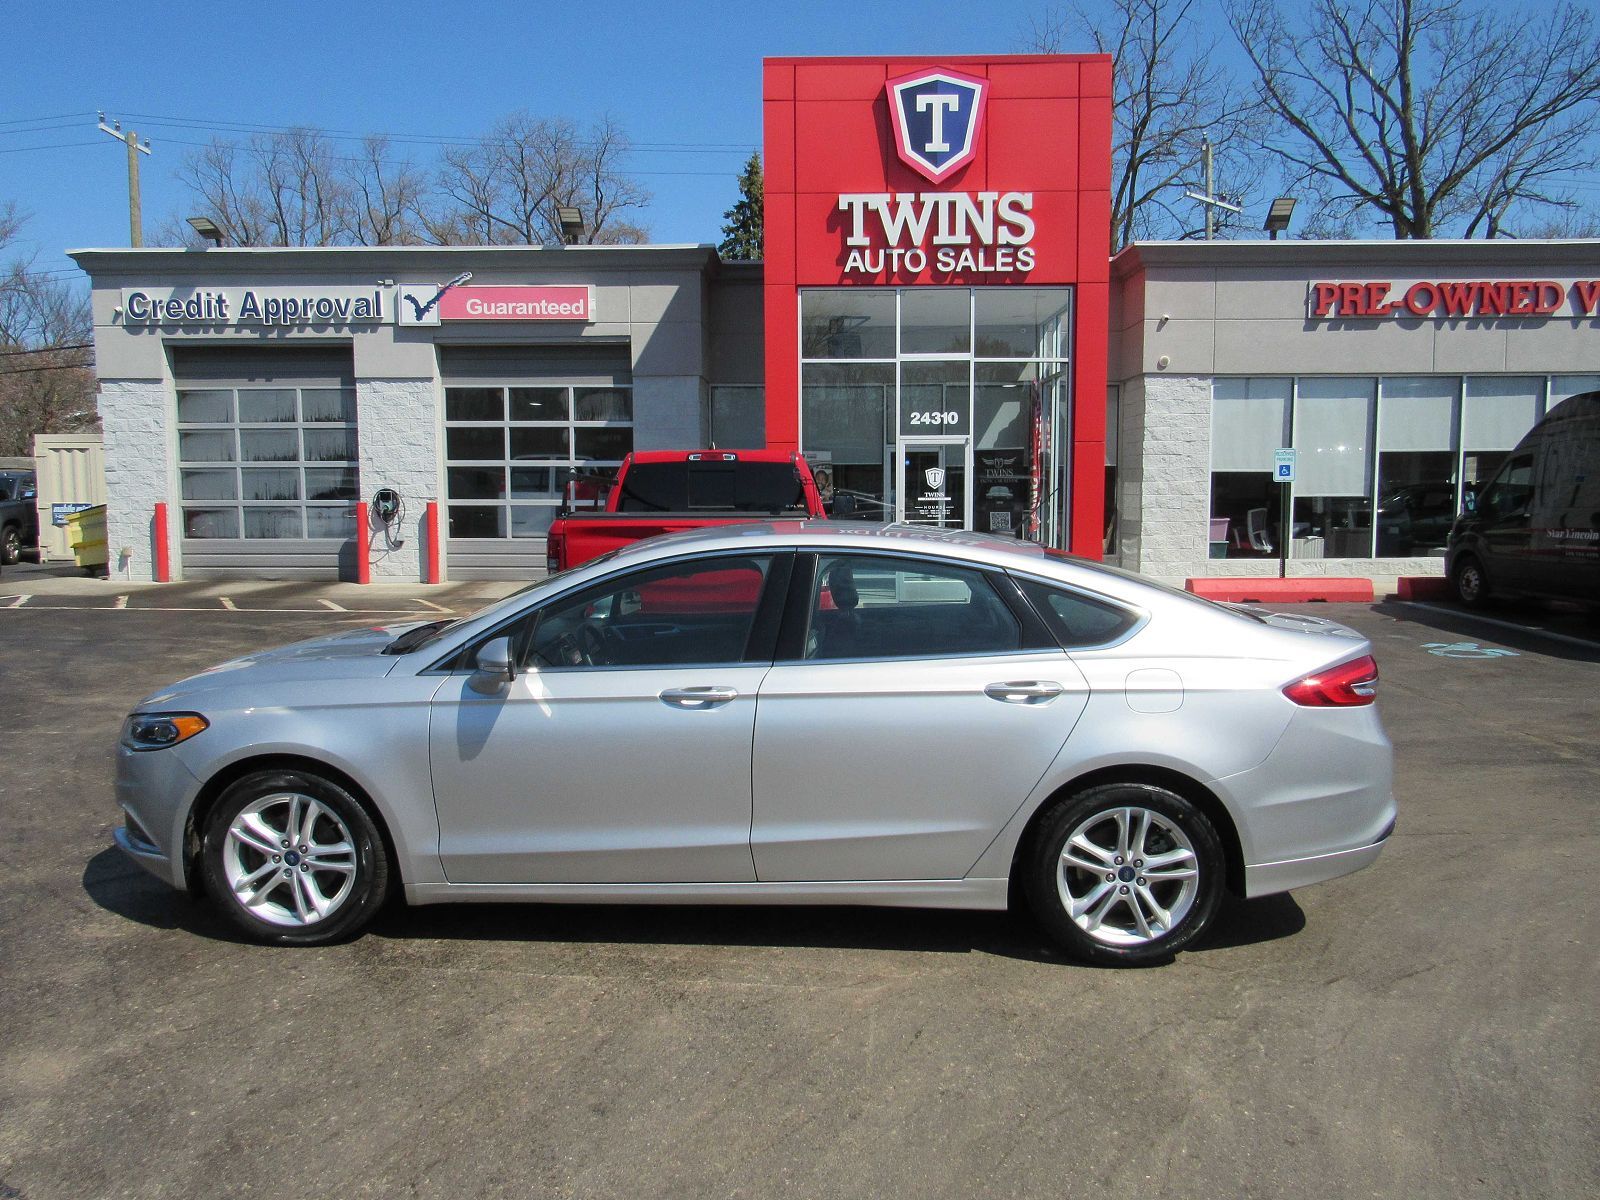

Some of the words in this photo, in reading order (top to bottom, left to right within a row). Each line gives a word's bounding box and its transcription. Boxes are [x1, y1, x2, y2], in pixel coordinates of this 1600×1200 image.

[916, 94, 959, 152] T
[838, 191, 1035, 246] TWINS
[844, 248, 927, 273] AUTO
[936, 247, 1035, 272] SALES
[127, 291, 230, 320] Credit
[239, 290, 385, 326] Approval
[466, 298, 584, 315] Guaranteed
[1314, 281, 1565, 316] PRE-OWNED
[910, 411, 959, 425] 24310
[984, 468, 1014, 477] TWINS
